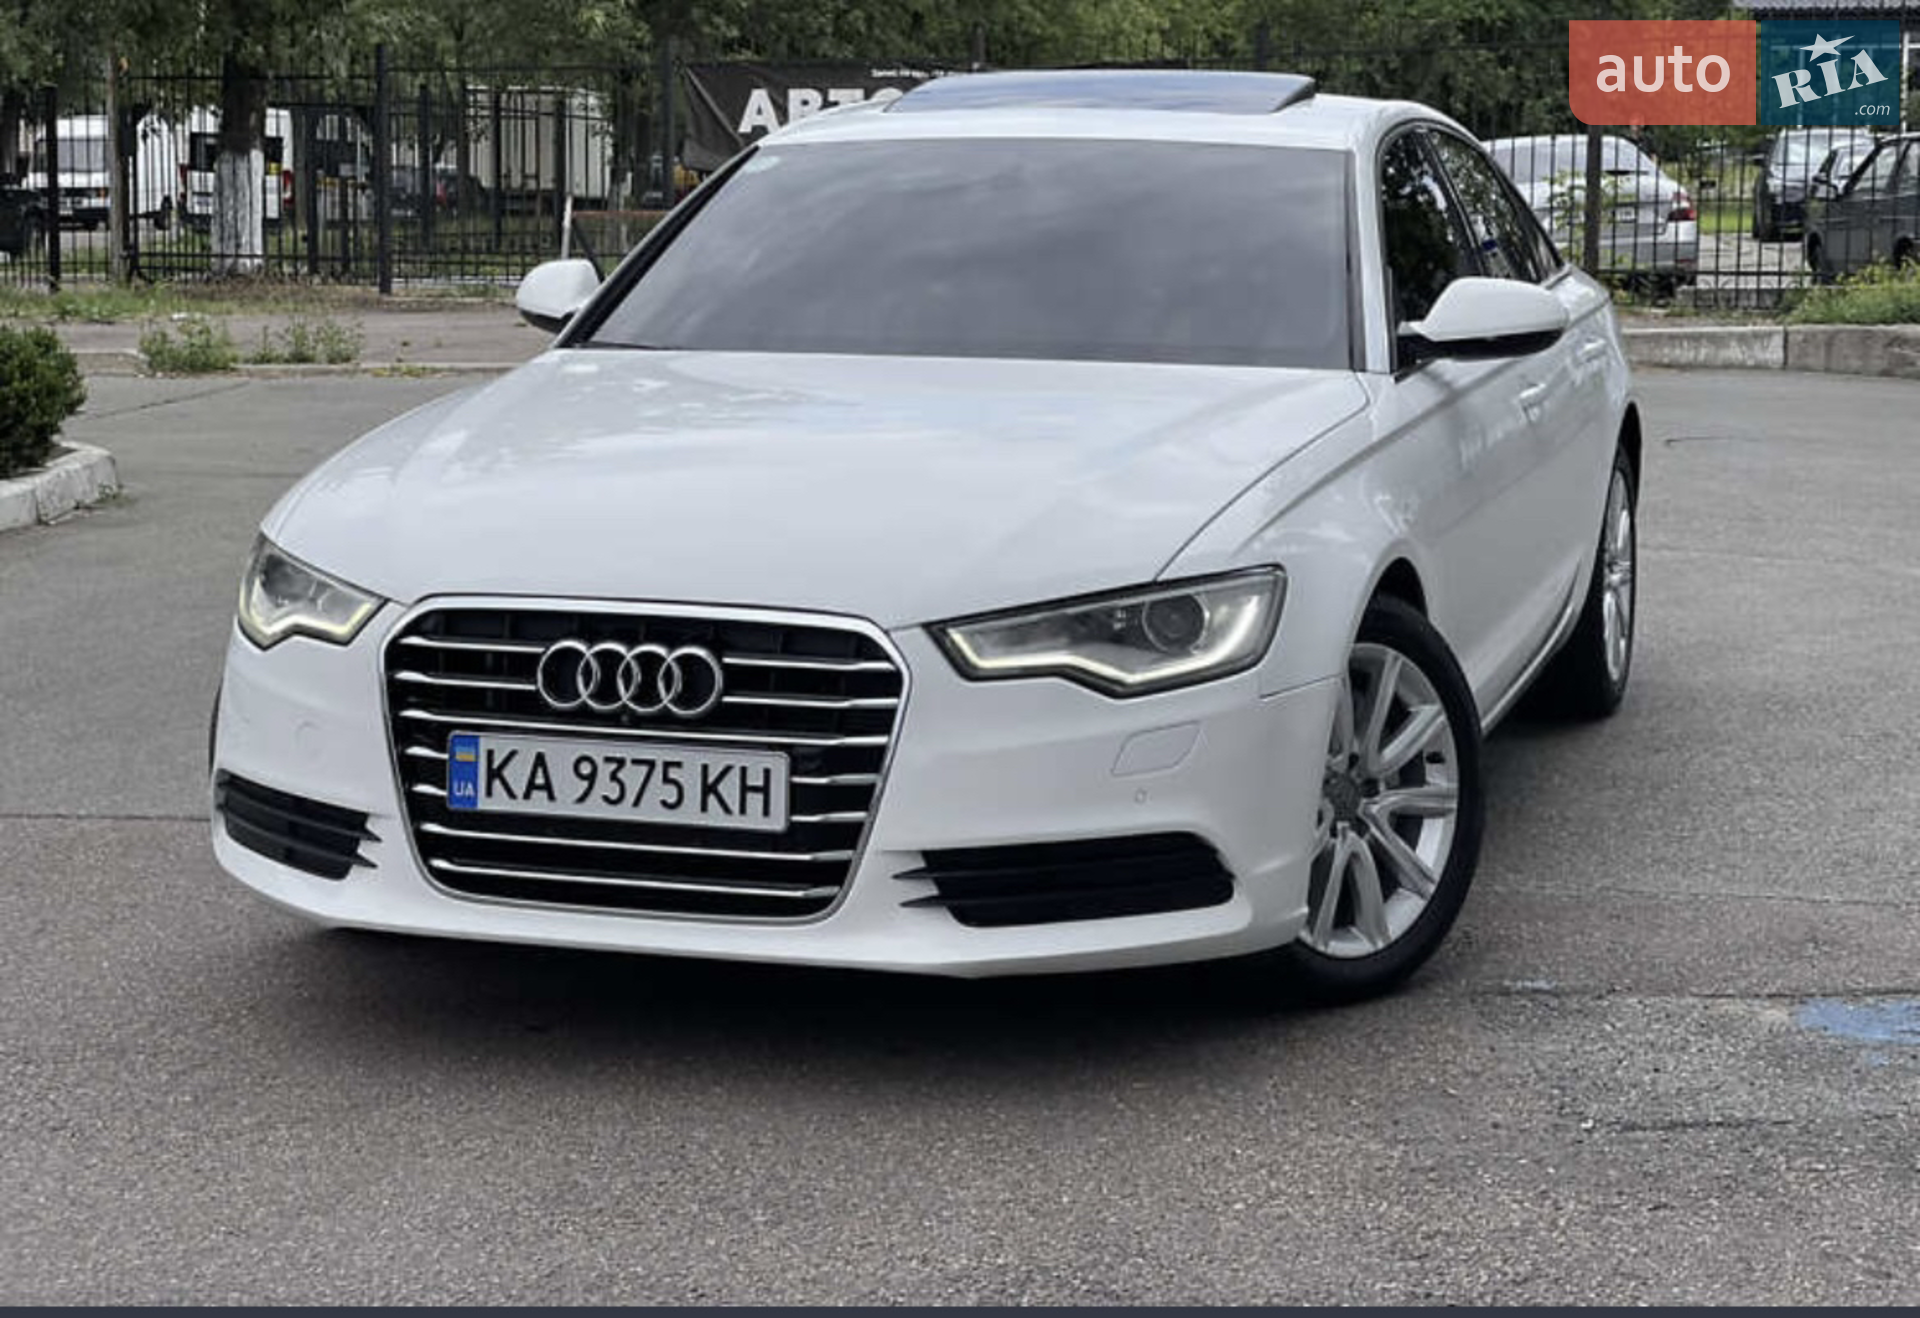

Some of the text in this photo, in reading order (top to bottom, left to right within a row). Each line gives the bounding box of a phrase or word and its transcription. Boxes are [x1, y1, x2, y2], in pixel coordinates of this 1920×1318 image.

[737, 88, 905, 134] АВ
[453, 782, 475, 797] UA
[484, 748, 771, 818] KA 9375 KH
